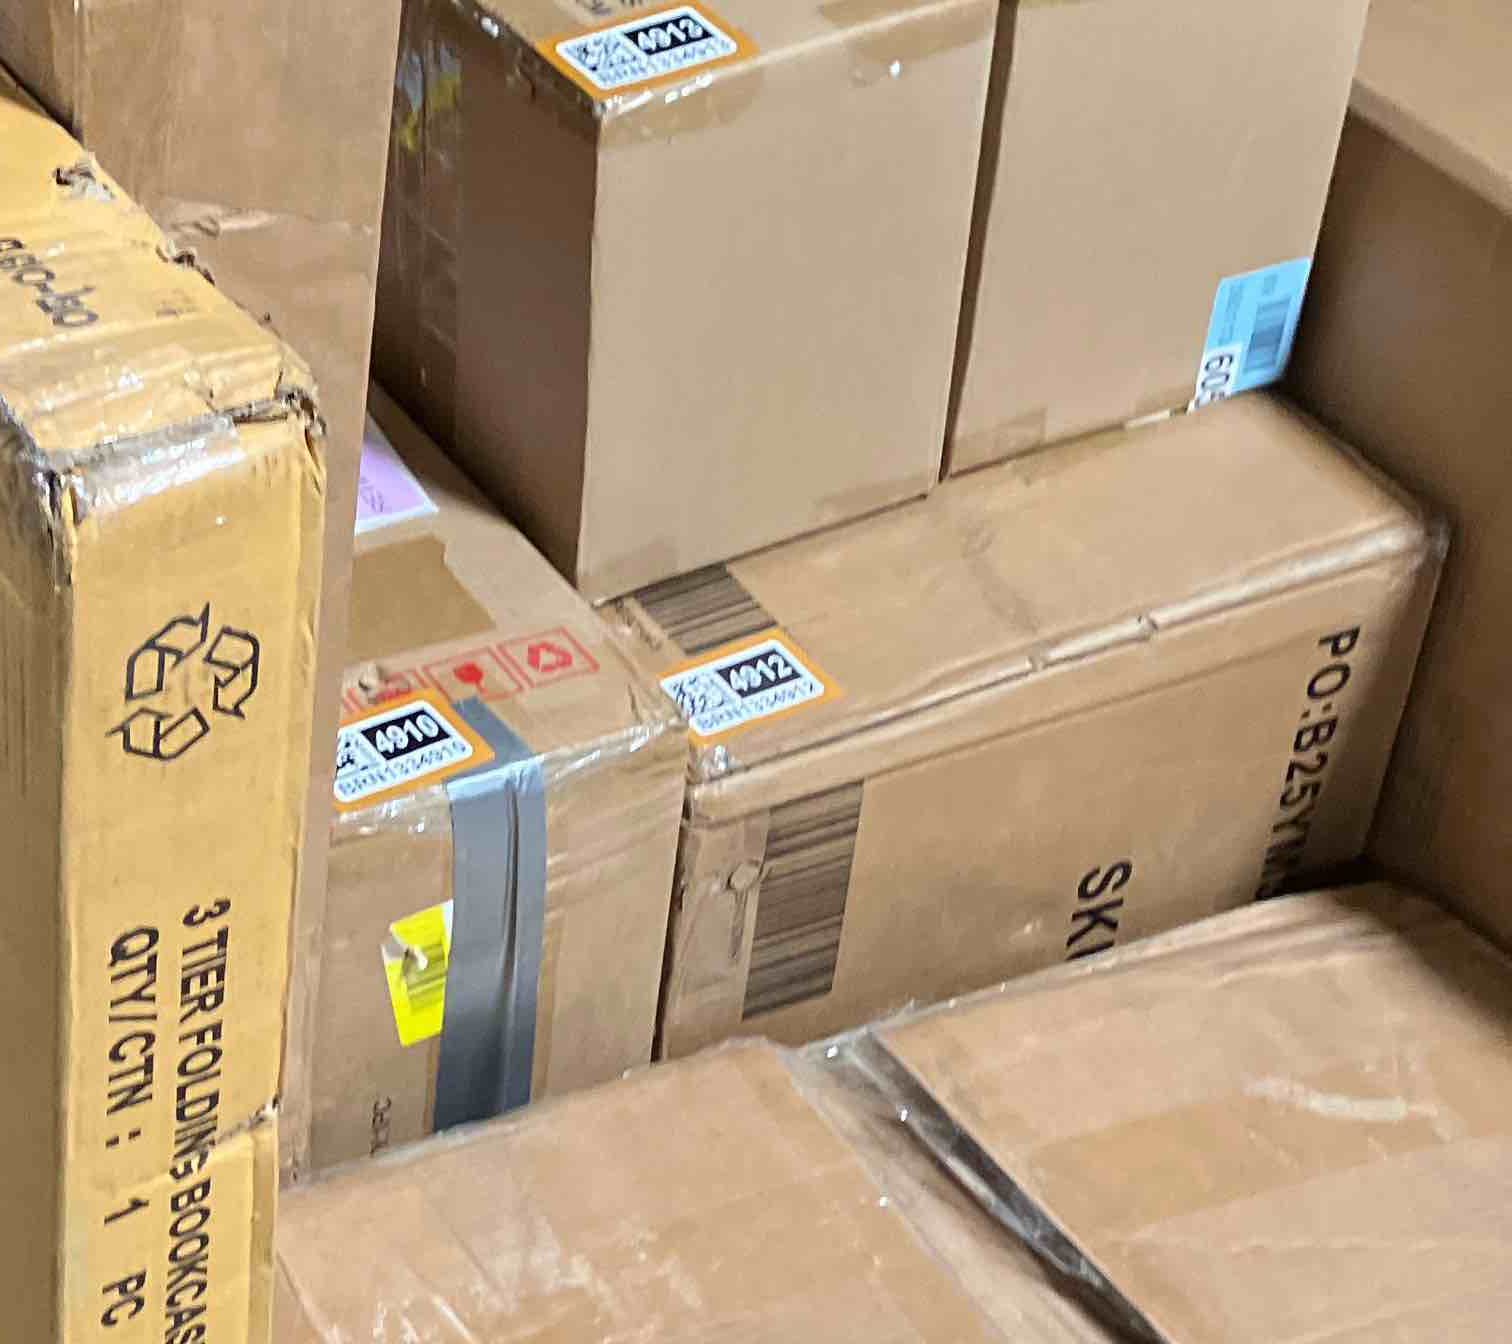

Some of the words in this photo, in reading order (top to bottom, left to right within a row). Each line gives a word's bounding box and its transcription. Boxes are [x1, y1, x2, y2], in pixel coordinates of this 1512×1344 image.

[375, 714, 439, 754] 4910
[183, 899, 231, 928] 3
[180, 927, 229, 1023] TIER
[104, 1197, 149, 1226] 1
[101, 1272, 147, 1328] PC
